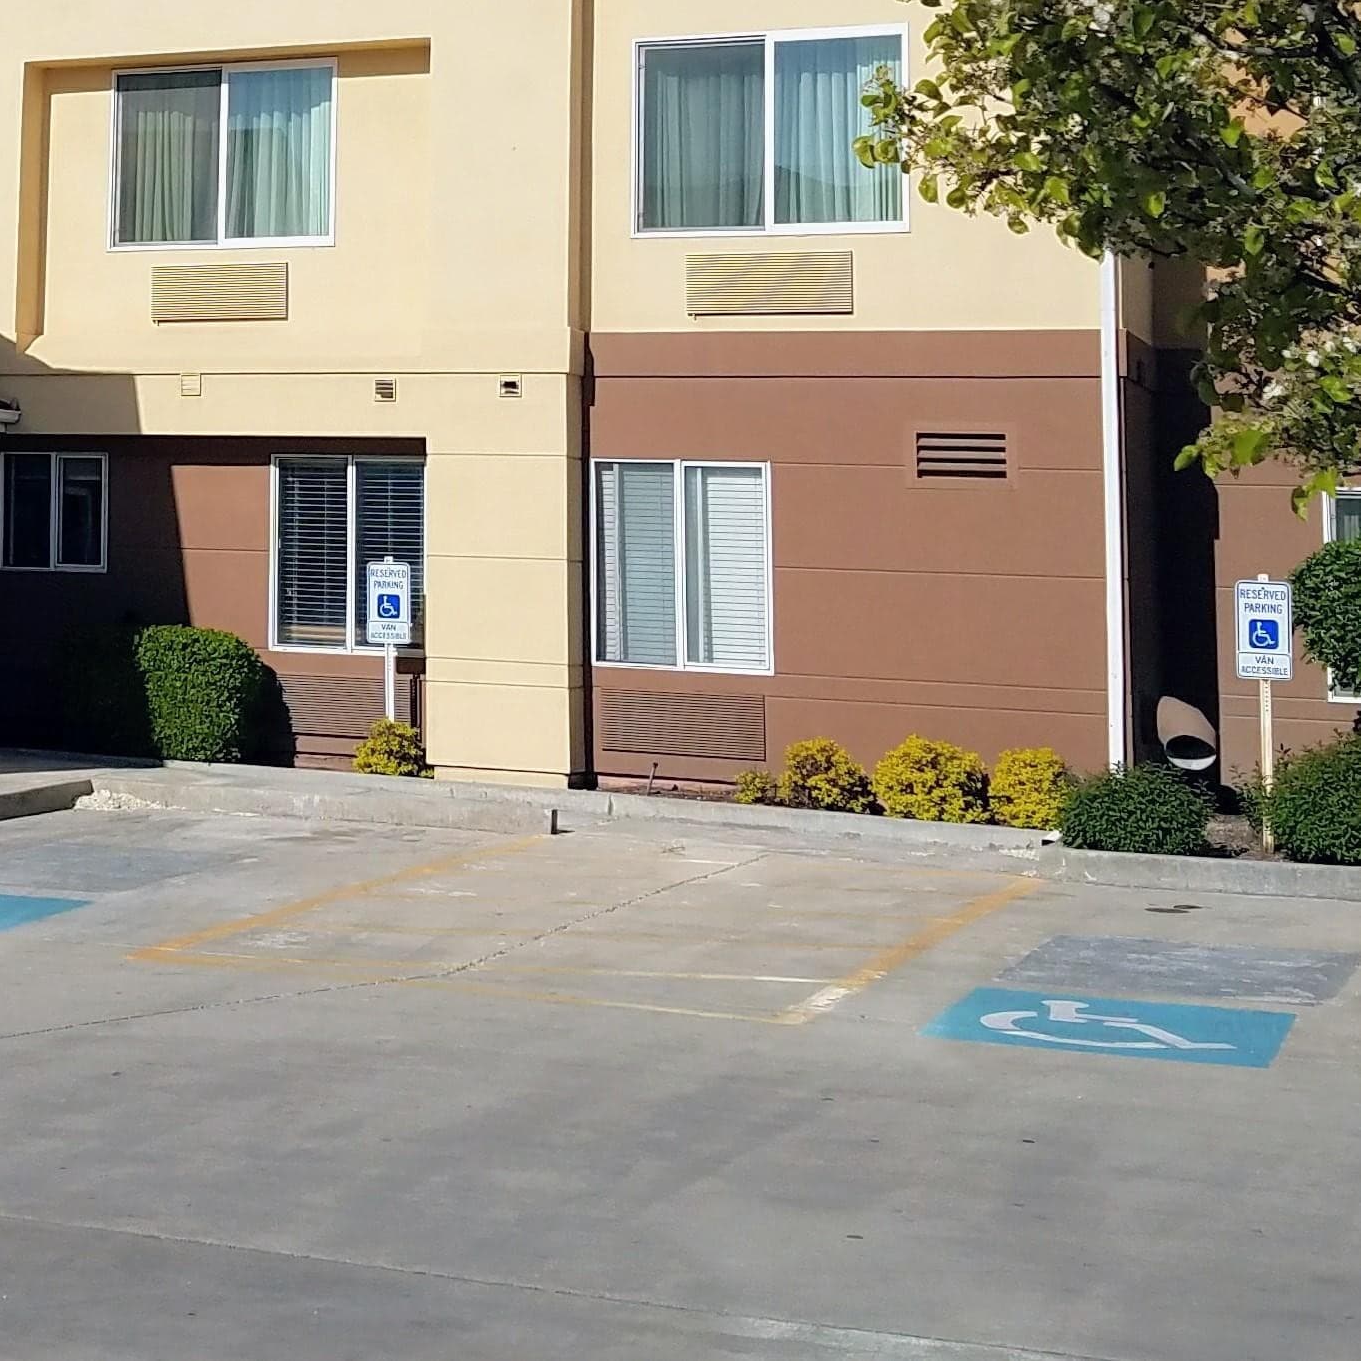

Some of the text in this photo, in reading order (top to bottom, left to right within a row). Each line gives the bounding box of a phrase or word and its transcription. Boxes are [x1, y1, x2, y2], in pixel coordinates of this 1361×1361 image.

[370, 569, 407, 579] RESERVED
[373, 580, 404, 590] PARKING
[1239, 588, 1287, 601] RESERVED
[1244, 602, 1283, 615] PARKING
[381, 623, 397, 631] VAN
[1254, 655, 1275, 665] VAN
[1241, 665, 1288, 676] ACCESSIBLE
